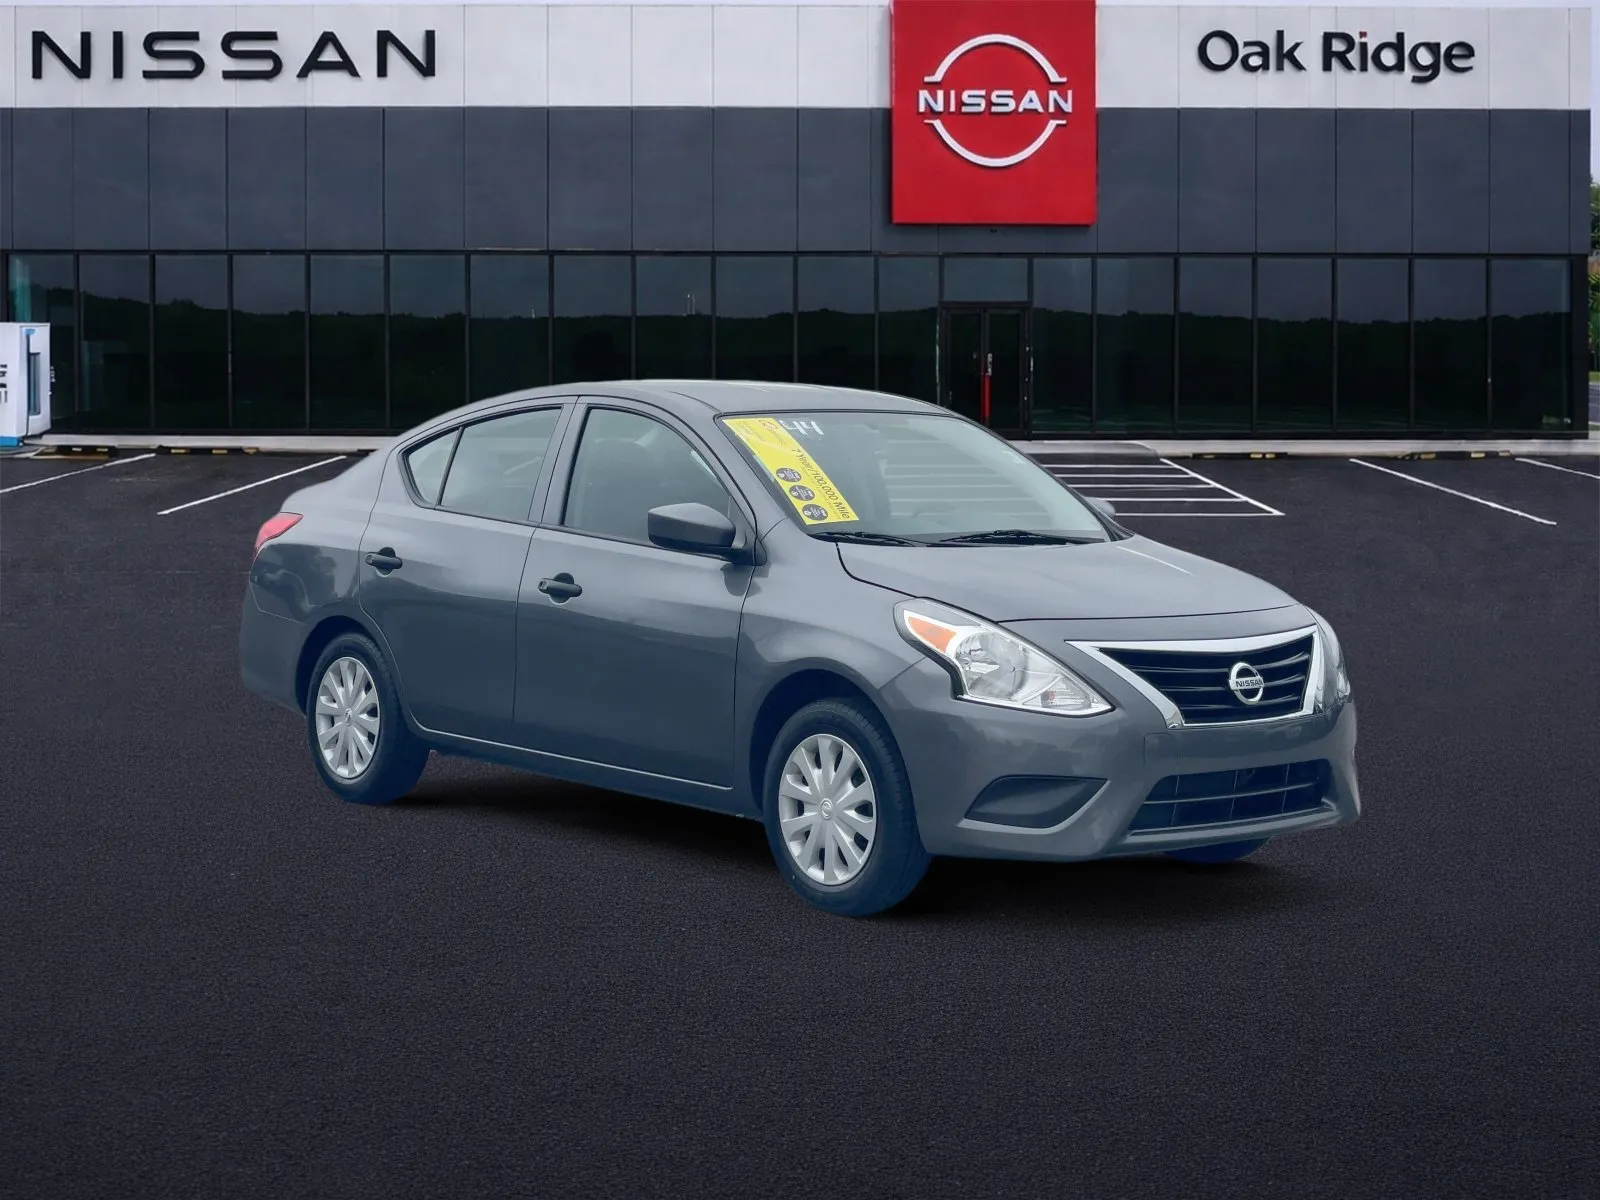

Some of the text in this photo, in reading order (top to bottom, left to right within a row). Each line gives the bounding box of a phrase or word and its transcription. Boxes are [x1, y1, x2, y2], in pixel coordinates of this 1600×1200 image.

[31, 29, 436, 79] NISSAN
[1198, 29, 1475, 83] Oak Ridge
[919, 89, 1072, 113] NISSAN
[833, 501, 850, 520] Mile
[1235, 679, 1264, 688] NISSAN
